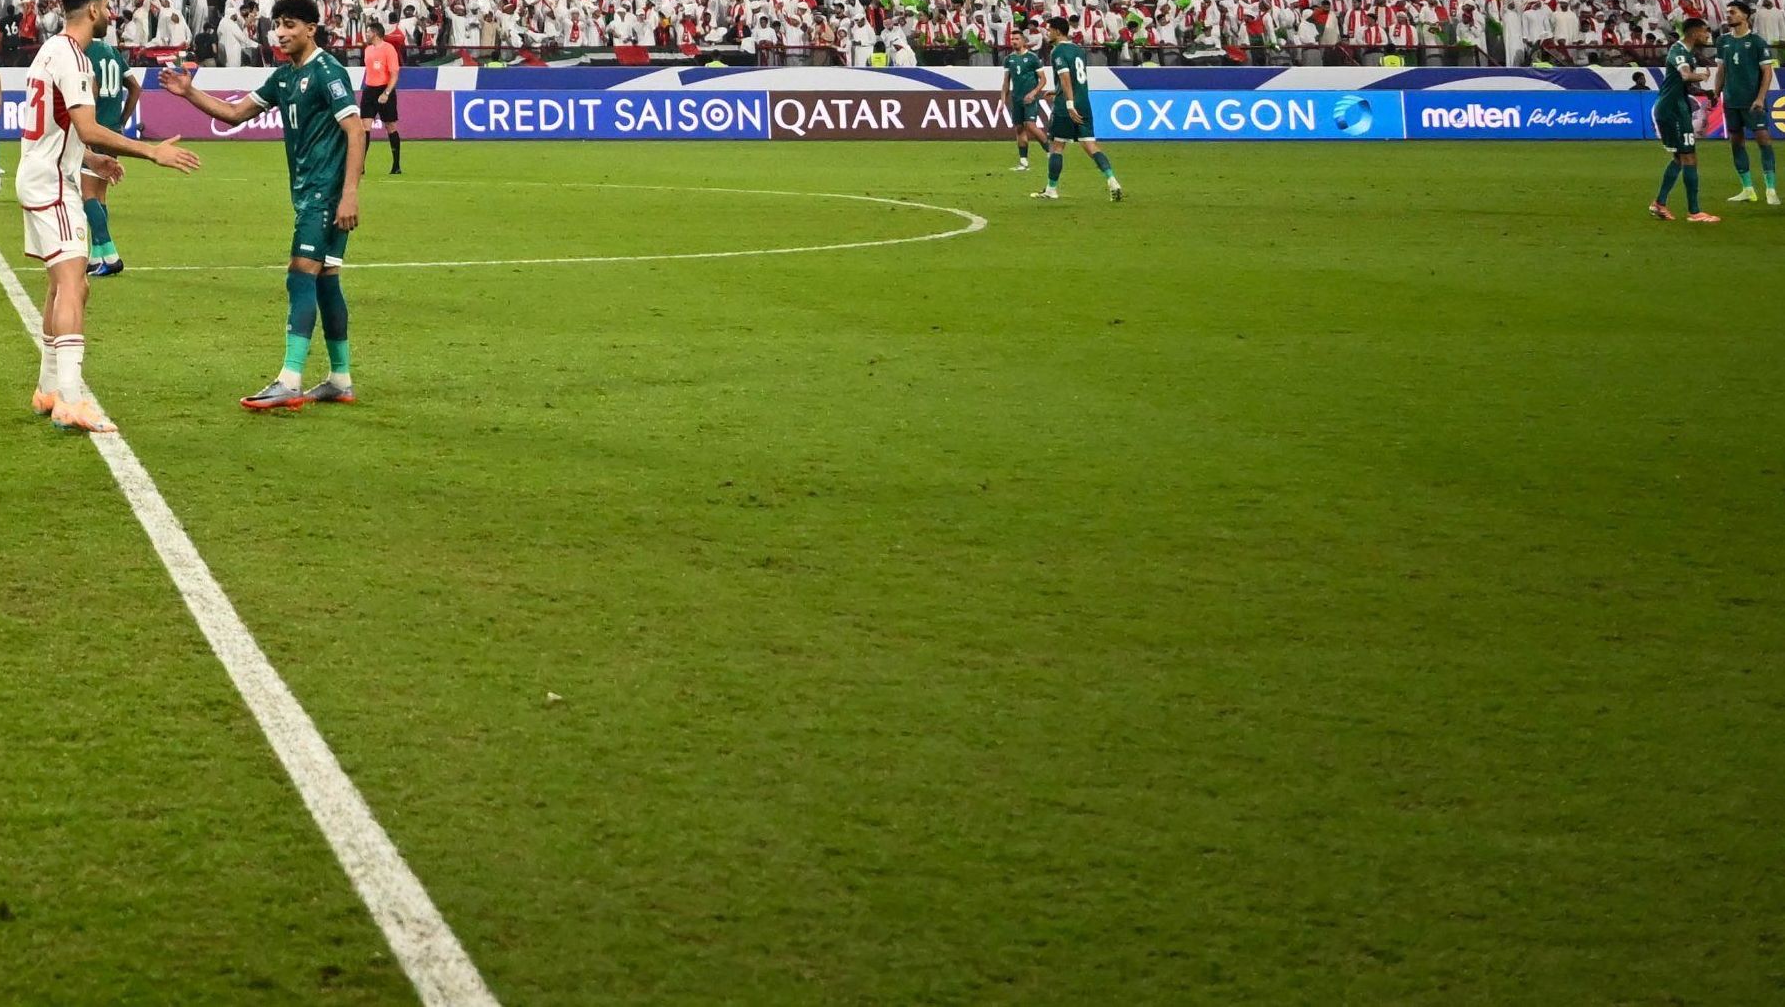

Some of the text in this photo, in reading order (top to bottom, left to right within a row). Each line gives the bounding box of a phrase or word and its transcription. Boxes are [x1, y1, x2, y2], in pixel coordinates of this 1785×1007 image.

[5, 21, 19, 36] 16
[1075, 57, 1088, 85] 8
[1732, 53, 1739, 65] 4
[98, 58, 121, 98] 10
[23, 77, 46, 142] 3
[463, 97, 762, 133] CREDIT SAISON
[773, 98, 904, 136] QATAR
[1111, 98, 1315, 131] OXAGON
[1421, 103, 1521, 129] molten
[1683, 132, 1696, 146] 16
